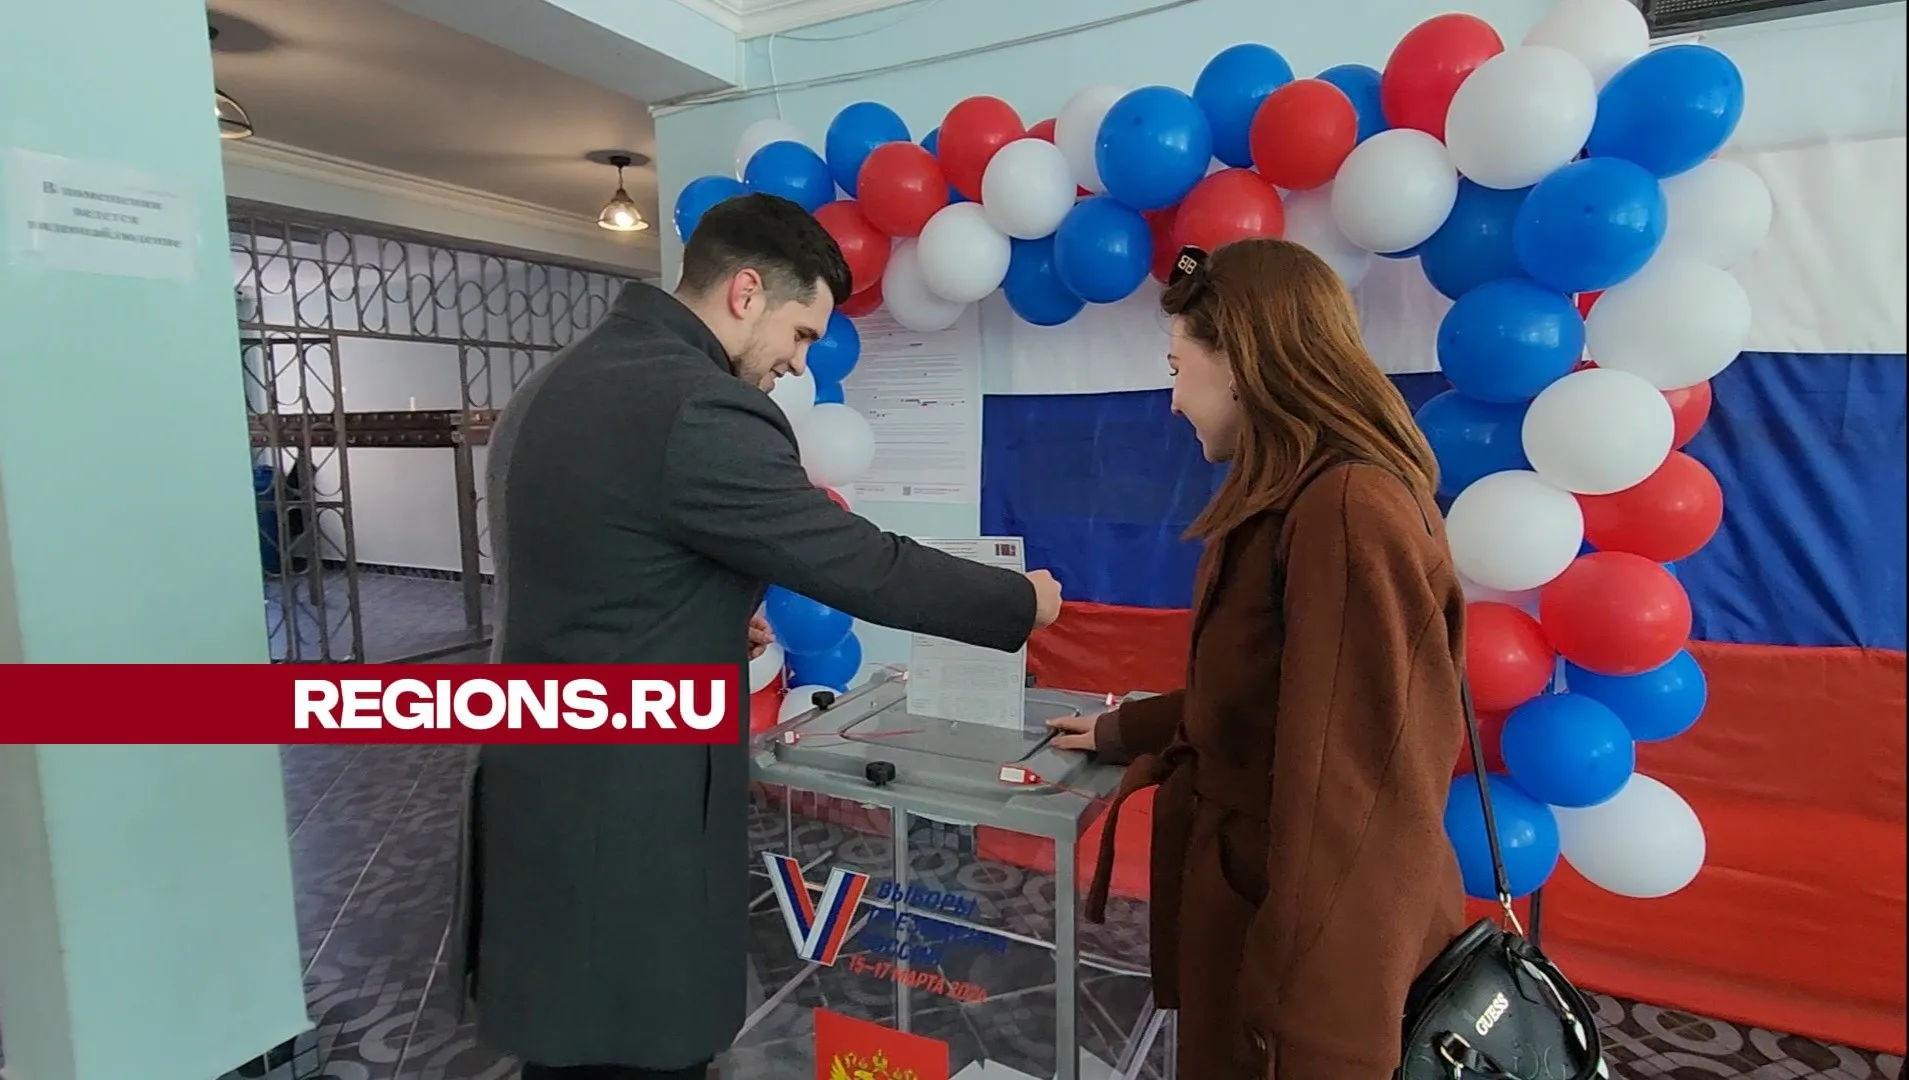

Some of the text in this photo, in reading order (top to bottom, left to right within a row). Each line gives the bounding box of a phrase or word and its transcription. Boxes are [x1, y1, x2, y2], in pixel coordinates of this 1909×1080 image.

[43, 181, 57, 194] В
[876, 880, 977, 916] ВЫБОРЫ
[891, 966, 945, 995] МАРТА
[1475, 991, 1509, 1036] GUESS
